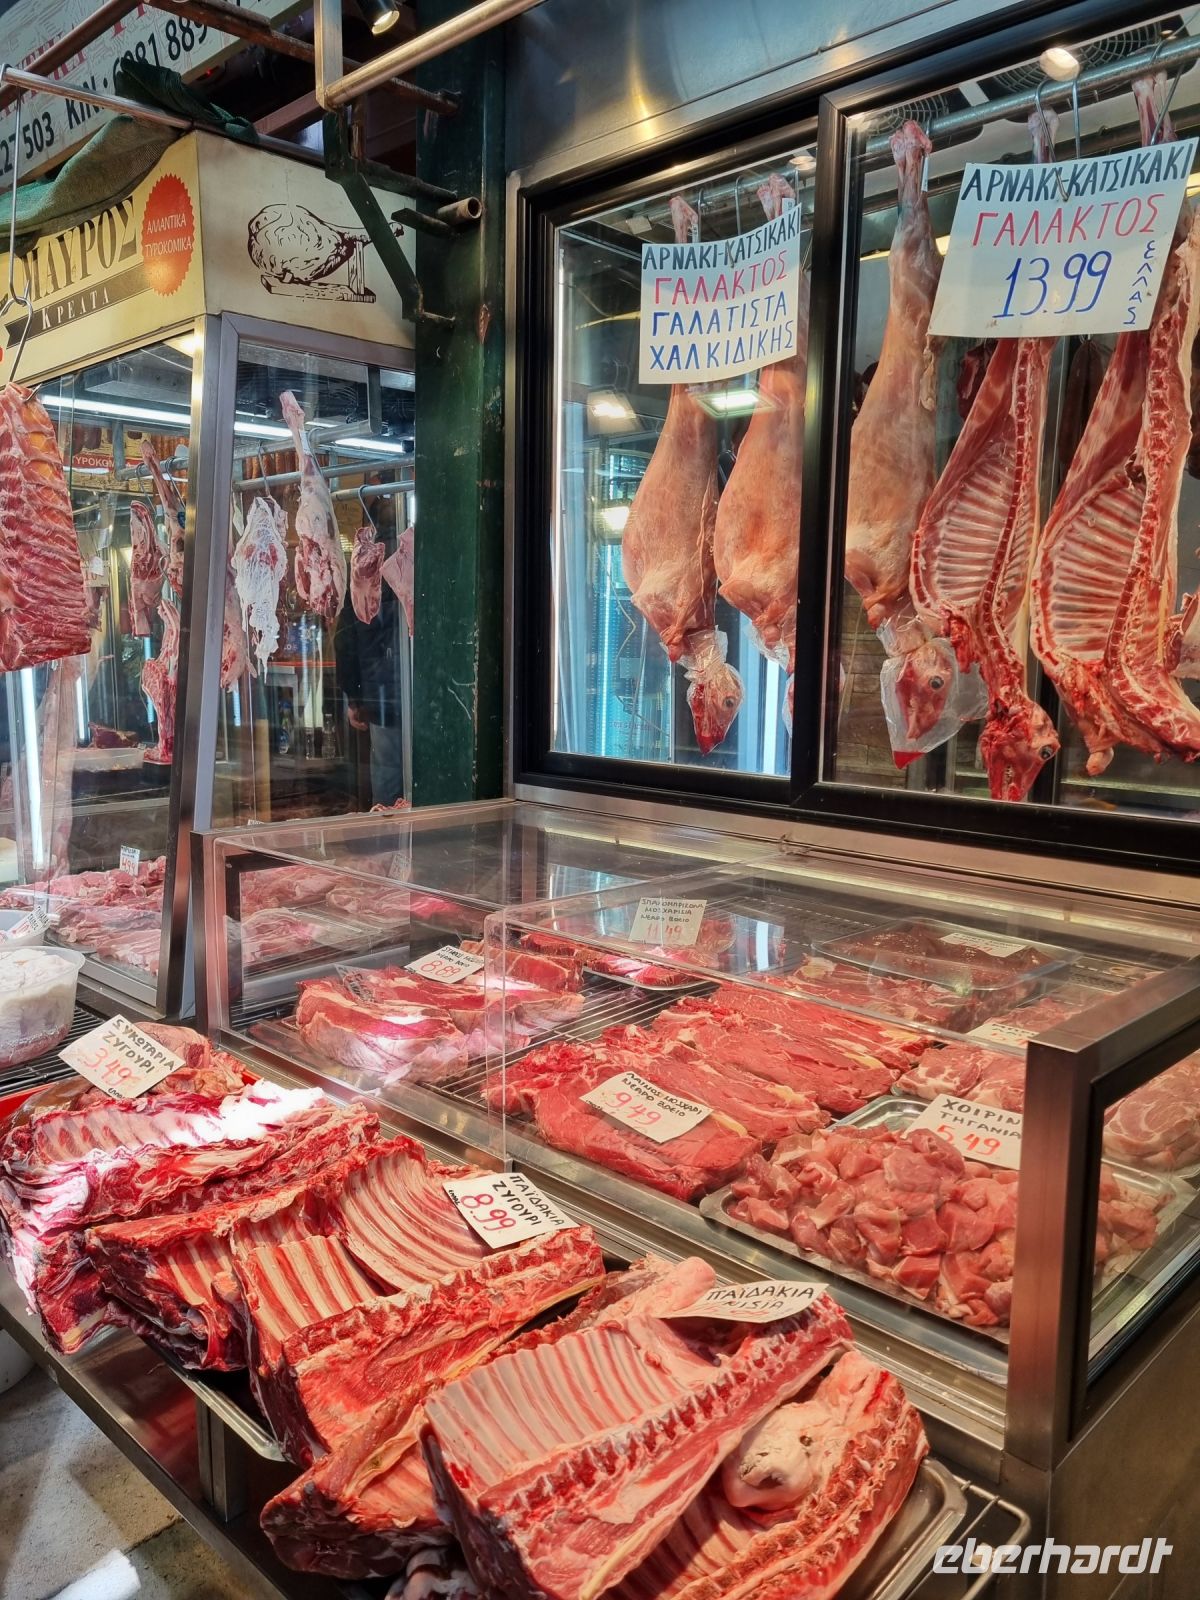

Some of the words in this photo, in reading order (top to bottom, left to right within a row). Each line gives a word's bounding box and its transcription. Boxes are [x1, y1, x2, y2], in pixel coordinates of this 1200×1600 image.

[23, 111, 54, 159] 503
[972, 193, 1166, 246] ΓΑΛΑΚΤΟΣ
[655, 250, 788, 304] ΓΑΛΑΚΤΟΣ
[992, 250, 1112, 318] 13.99
[652, 291, 787, 336] ΓΑΛΑΤΙΣΤΑ
[650, 320, 793, 370] ΧΑΛΚΙΔΙΚΗΣ
[103, 1031, 155, 1073] ΖΥΓΟΥΡΙ
[460, 1194, 516, 1231] 8.99
[492, 1181, 542, 1225] ΖΥΓΟΥΡΙ
